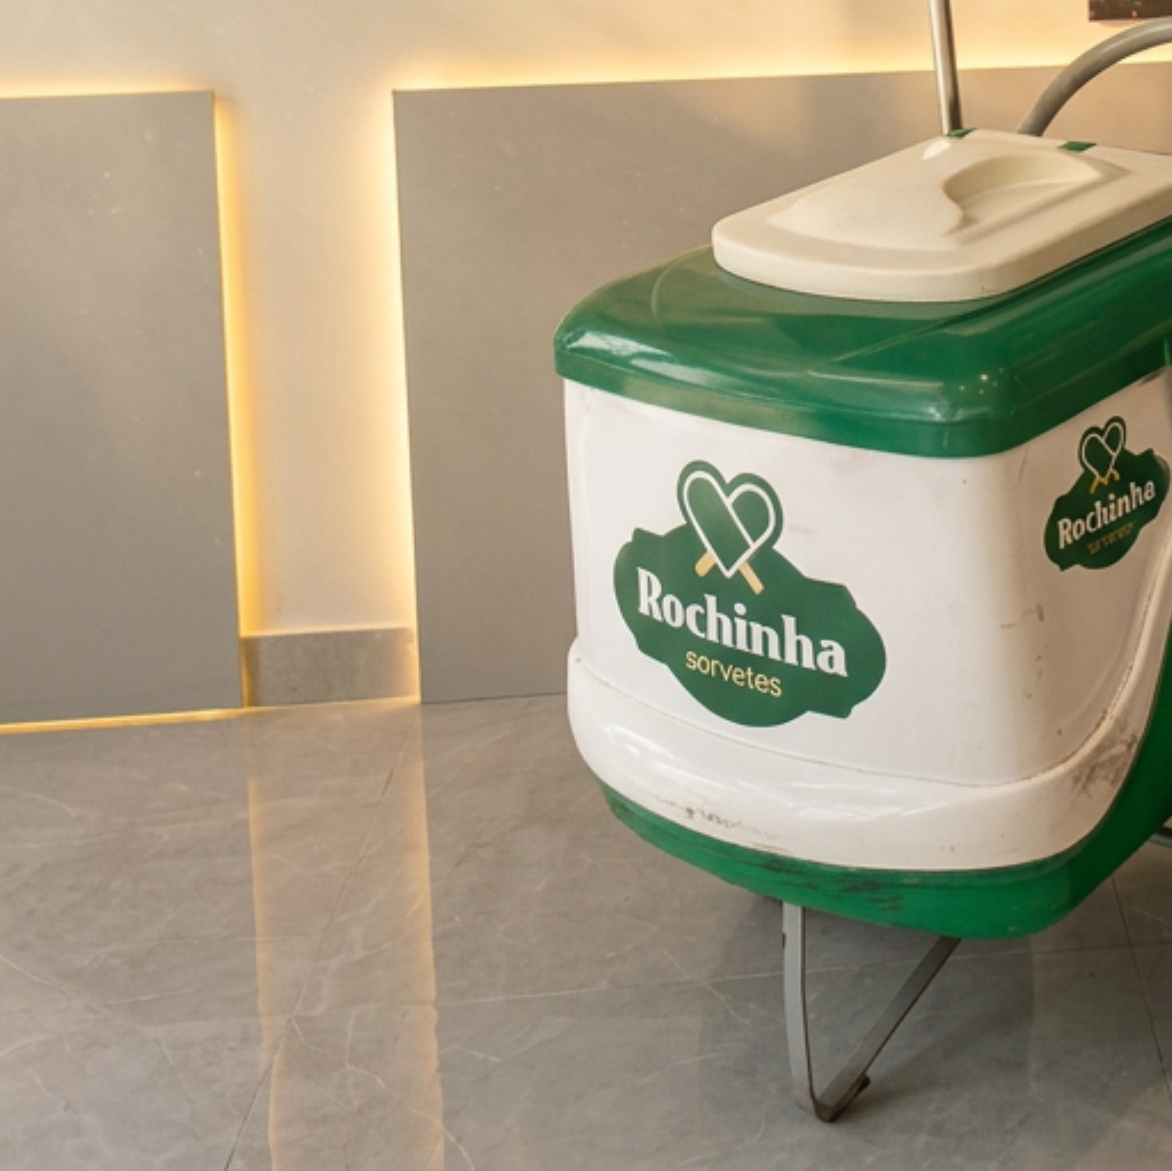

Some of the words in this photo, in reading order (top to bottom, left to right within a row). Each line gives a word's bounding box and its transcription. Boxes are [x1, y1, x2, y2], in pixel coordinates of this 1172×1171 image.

[1057, 480, 1156, 549] Rochinha
[636, 566, 848, 678] Rochinha
[685, 650, 783, 698] sorvetes
